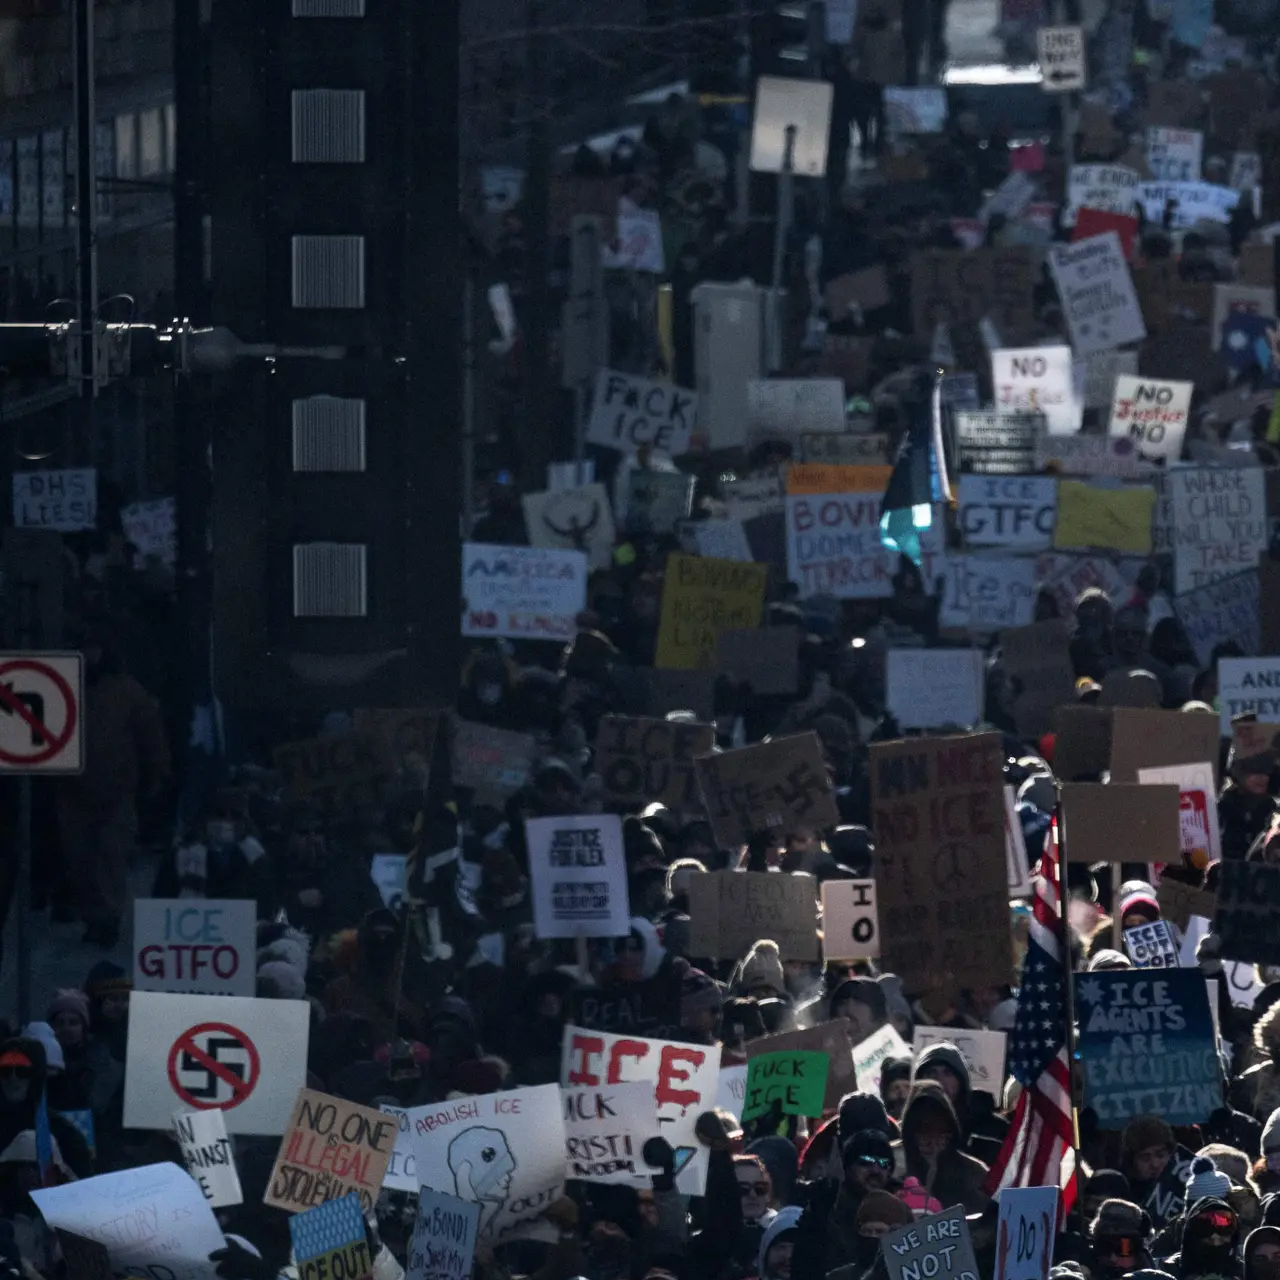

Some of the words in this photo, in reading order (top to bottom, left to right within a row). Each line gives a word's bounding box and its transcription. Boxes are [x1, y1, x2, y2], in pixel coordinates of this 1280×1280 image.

[1136, 384, 1172, 404] NO
[1130, 422, 1164, 442] NO
[164, 907, 223, 941] ICE
[140, 945, 238, 980] GTFO
[1110, 981, 1169, 1004] ICE
[1087, 1005, 1185, 1031] AGENTS
[569, 1037, 706, 1108] ICE
[753, 1059, 805, 1083] FUCK
[747, 1085, 801, 1109] ICE
[298, 1099, 338, 1131] NO
[341, 1112, 394, 1149] ONE
[416, 1102, 479, 1135] ABOLISH
[495, 1098, 521, 1116] ICE
[891, 1230, 920, 1256] WE
[926, 1218, 962, 1241] ARE
